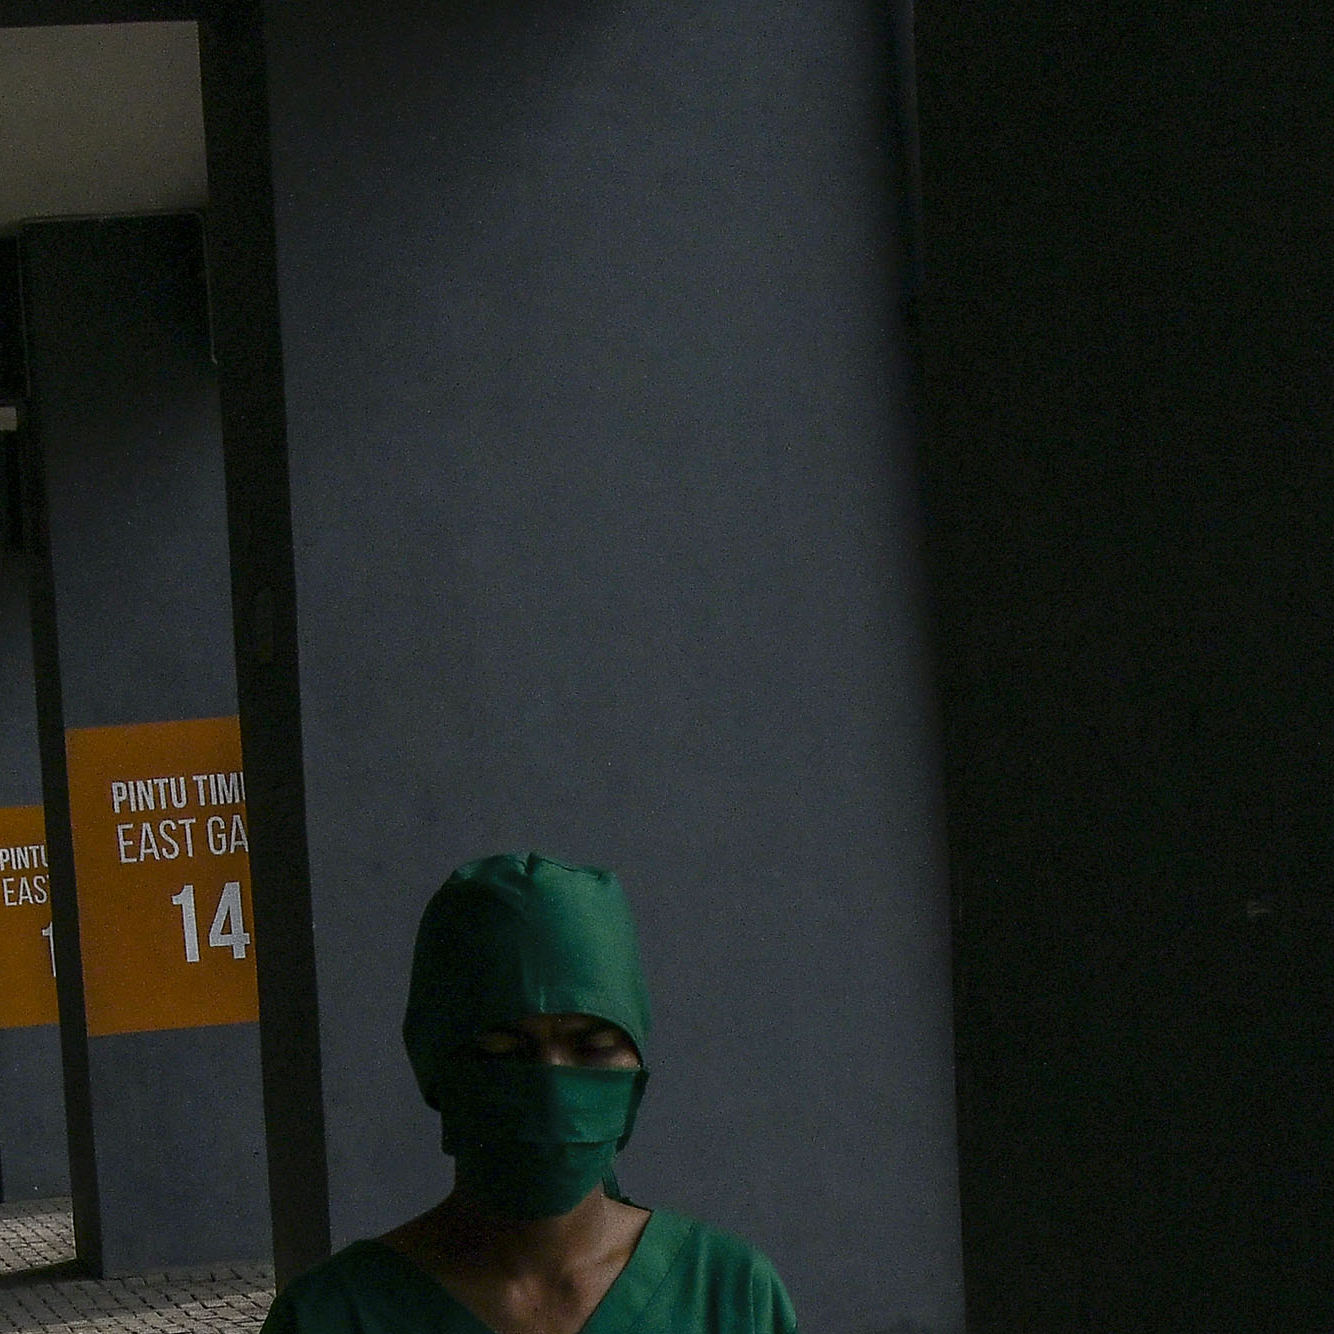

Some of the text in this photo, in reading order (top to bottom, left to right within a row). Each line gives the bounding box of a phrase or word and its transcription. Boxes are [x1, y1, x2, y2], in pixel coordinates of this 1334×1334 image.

[111, 771, 247, 814] PINTU TIM
[116, 814, 250, 864] EAST GA
[2, 874, 50, 907] EAS
[171, 881, 251, 963] 14
[41, 920, 58, 977] 1
